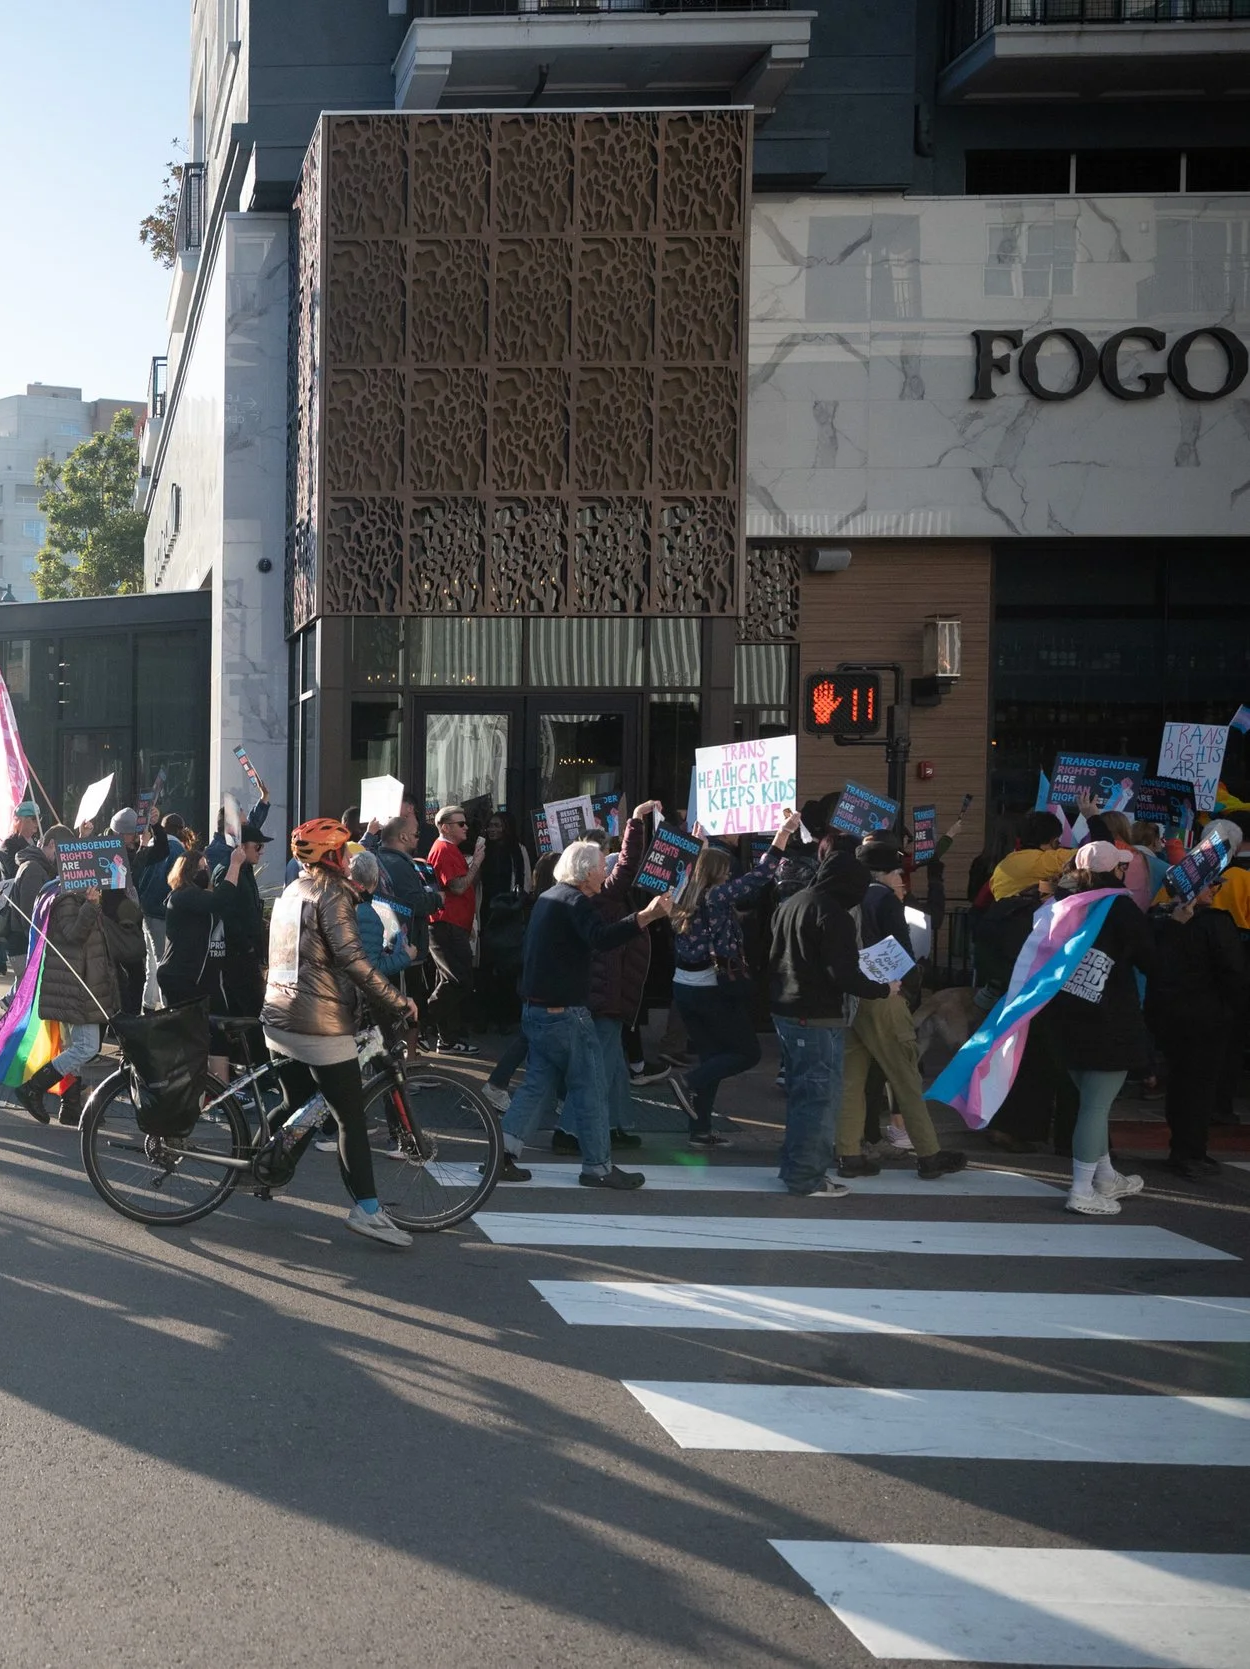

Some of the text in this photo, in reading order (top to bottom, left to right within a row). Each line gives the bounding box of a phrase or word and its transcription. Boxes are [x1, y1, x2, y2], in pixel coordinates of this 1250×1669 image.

[969, 327, 1248, 400] FOGO
[852, 687, 874, 721] 11
[1165, 724, 1226, 745] TRANS
[721, 740, 766, 761] TRANS
[1163, 742, 1224, 763] RIGHTS
[698, 756, 780, 788] HEALTHCARE
[1057, 765, 1097, 776] RIGHTS
[1060, 756, 1141, 772] TRANSGENDER
[1171, 761, 1207, 778] ARE
[1055, 774, 1076, 784] ARE
[708, 779, 796, 812] KEEPS KIDS
[1051, 793, 1078, 802] RIGH
[1053, 783, 1091, 795] HUMAN
[839, 801, 855, 813] ARE
[842, 792, 870, 810] RIGHTS
[846, 784, 896, 814] TRANSGENDER
[724, 803, 782, 835] ALIVE
[833, 816, 860, 834] RIGHTS
[836, 809, 863, 826] HUMAN
[57, 840, 122, 852] TRANSGENDER
[653, 840, 679, 858] RIGHTS
[60, 851, 93, 862] RIGHTS
[648, 851, 665, 865] ARE
[62, 861, 80, 871] ARE
[63, 869, 95, 880] HUMAN
[643, 862, 672, 880] HUMAN
[64, 878, 99, 890] RIGHTS
[637, 873, 668, 892] RIGHTS
